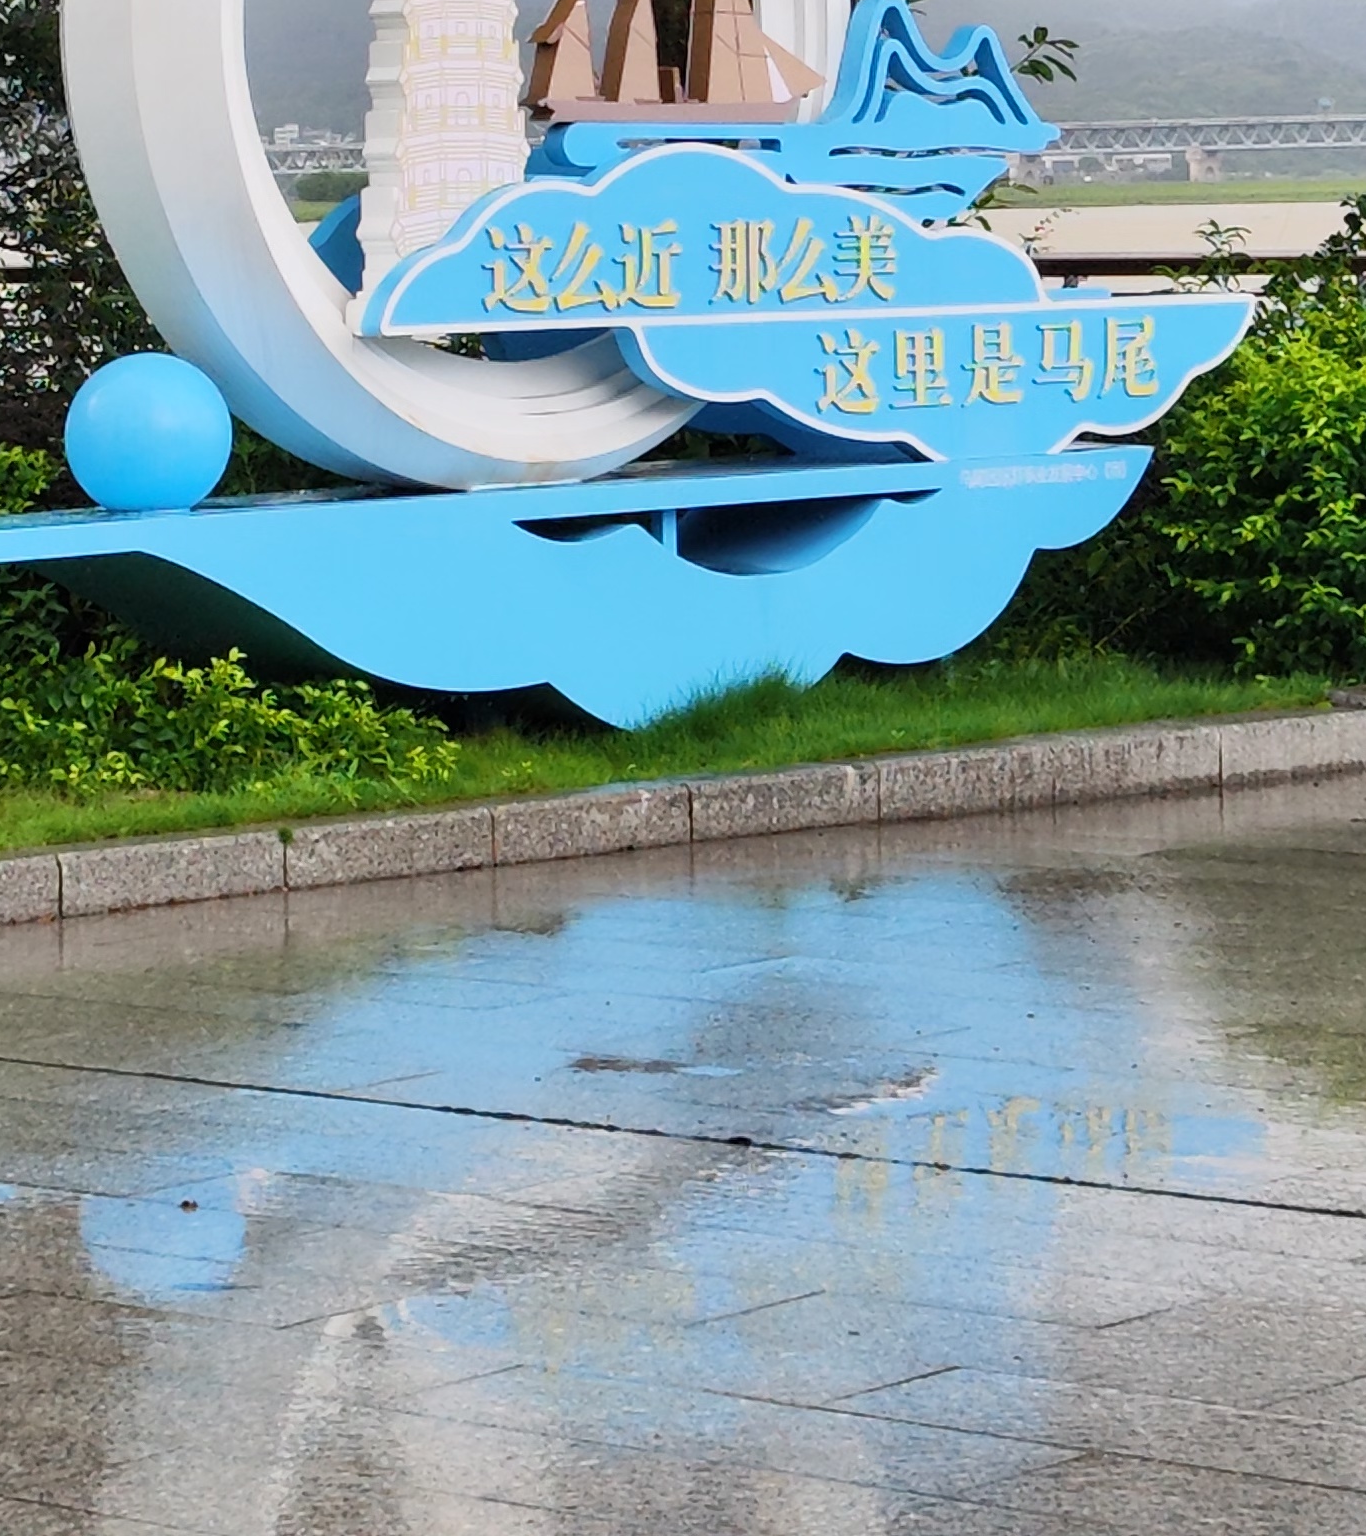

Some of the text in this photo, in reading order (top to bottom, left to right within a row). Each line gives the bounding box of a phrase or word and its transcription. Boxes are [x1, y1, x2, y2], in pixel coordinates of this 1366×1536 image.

[482, 215, 897, 313] 这么近 那么美
[815, 314, 1160, 415] 这里是马尾
